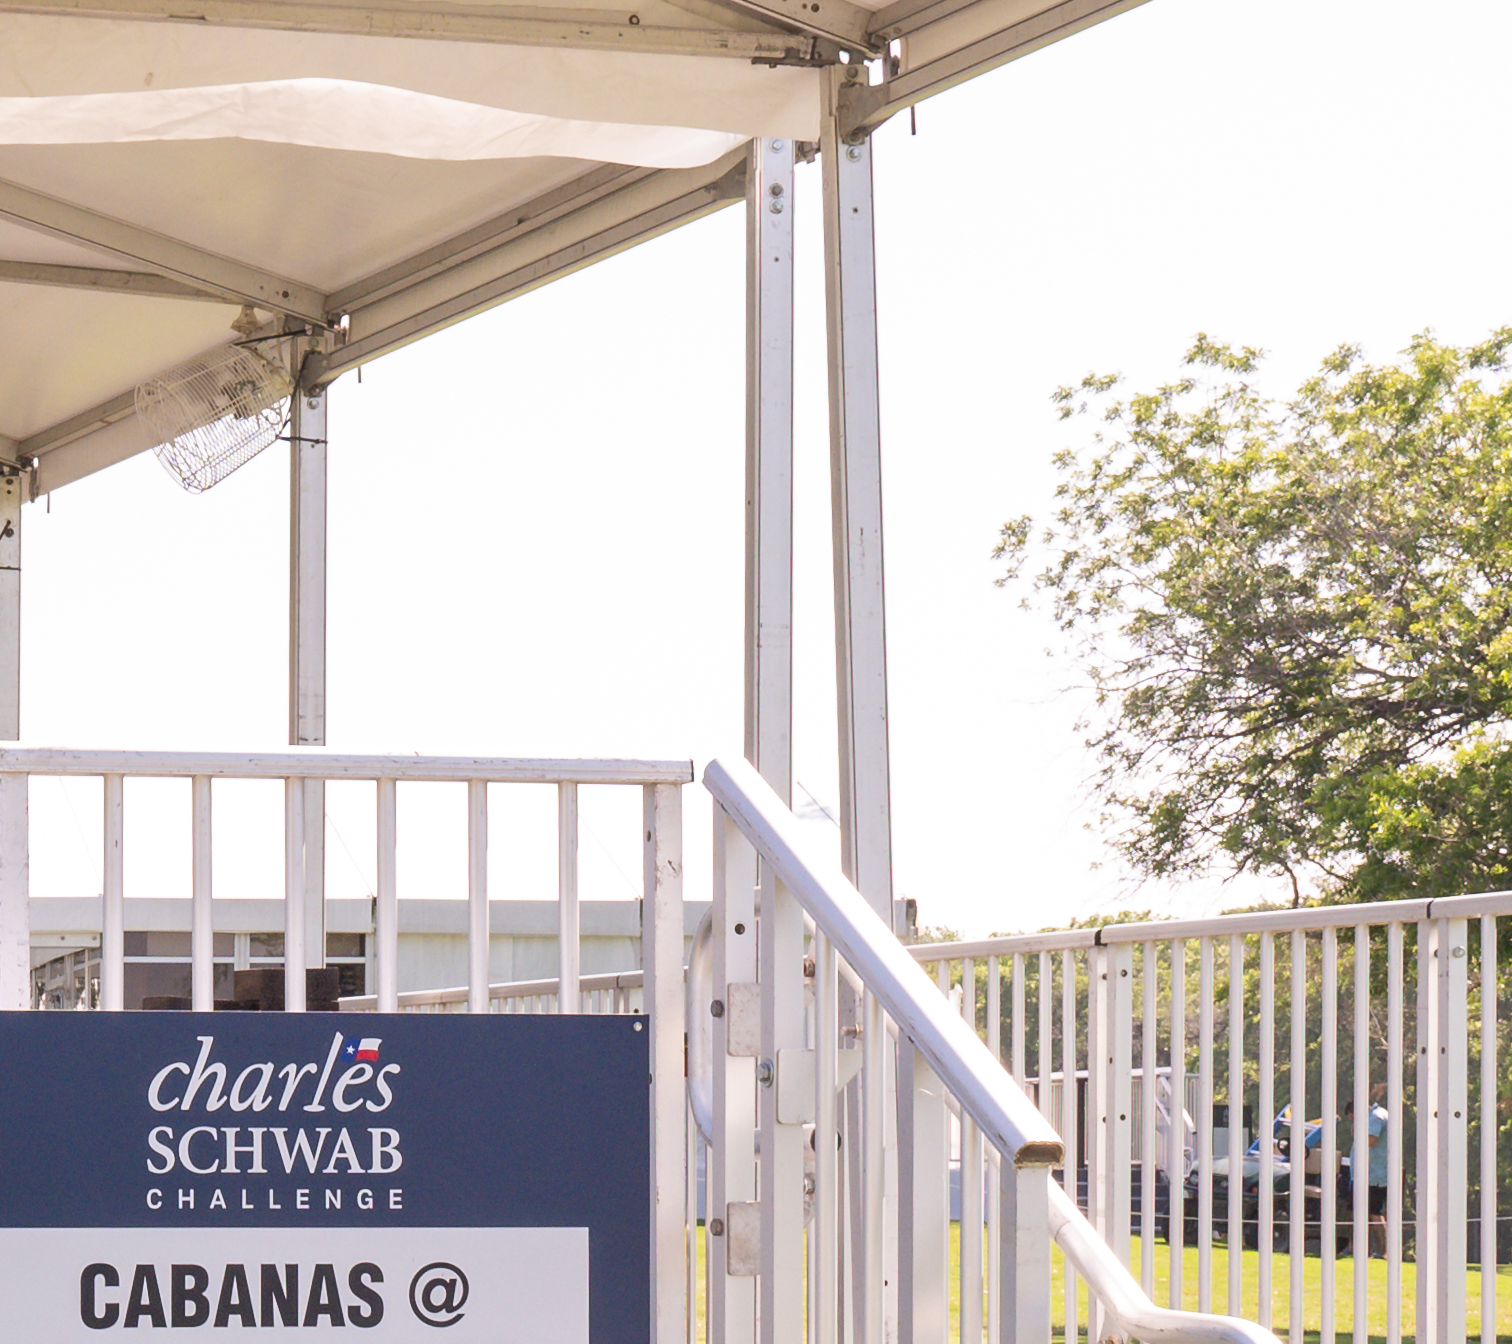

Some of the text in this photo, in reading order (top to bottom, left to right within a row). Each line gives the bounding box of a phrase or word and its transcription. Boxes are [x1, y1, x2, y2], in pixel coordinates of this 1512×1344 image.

[148, 1031, 400, 1112] charles
[147, 1126, 402, 1173] SCHWAB
[147, 1189, 402, 1209] CHALLENGE
[81, 1262, 469, 1329] CABANAS @
